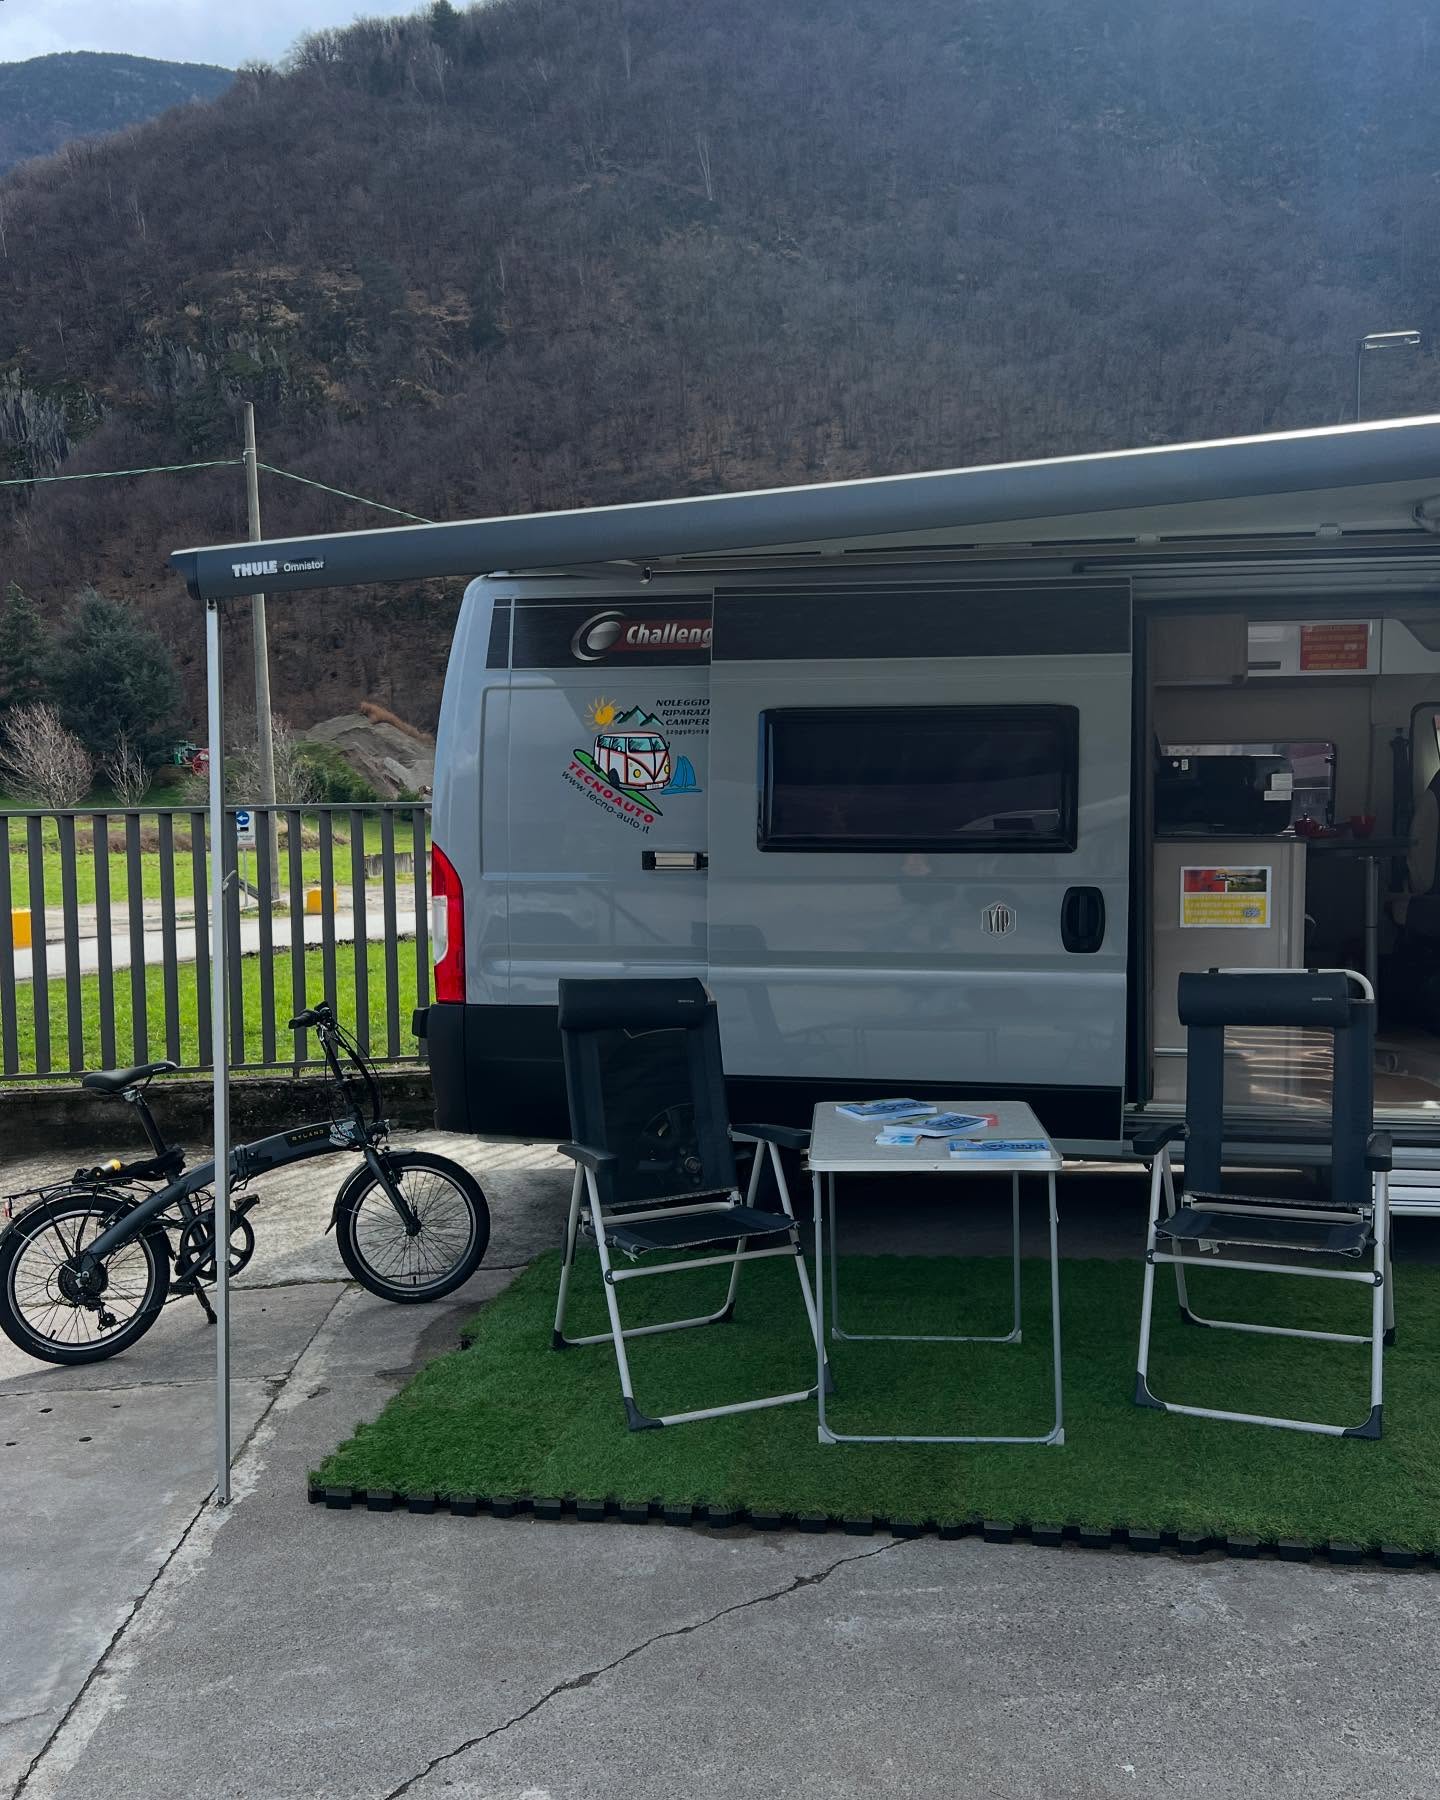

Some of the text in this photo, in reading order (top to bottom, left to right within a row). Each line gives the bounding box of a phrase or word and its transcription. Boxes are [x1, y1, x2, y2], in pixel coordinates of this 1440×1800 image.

[231, 560, 325, 578] THULE Omnistor
[626, 623, 713, 648] Challeng
[656, 698, 711, 707] NOLEGGIO
[665, 718, 710, 726] CAMPER
[562, 770, 650, 834] www.tecno-auto.it
[568, 760, 655, 824] TECNOAUTO
